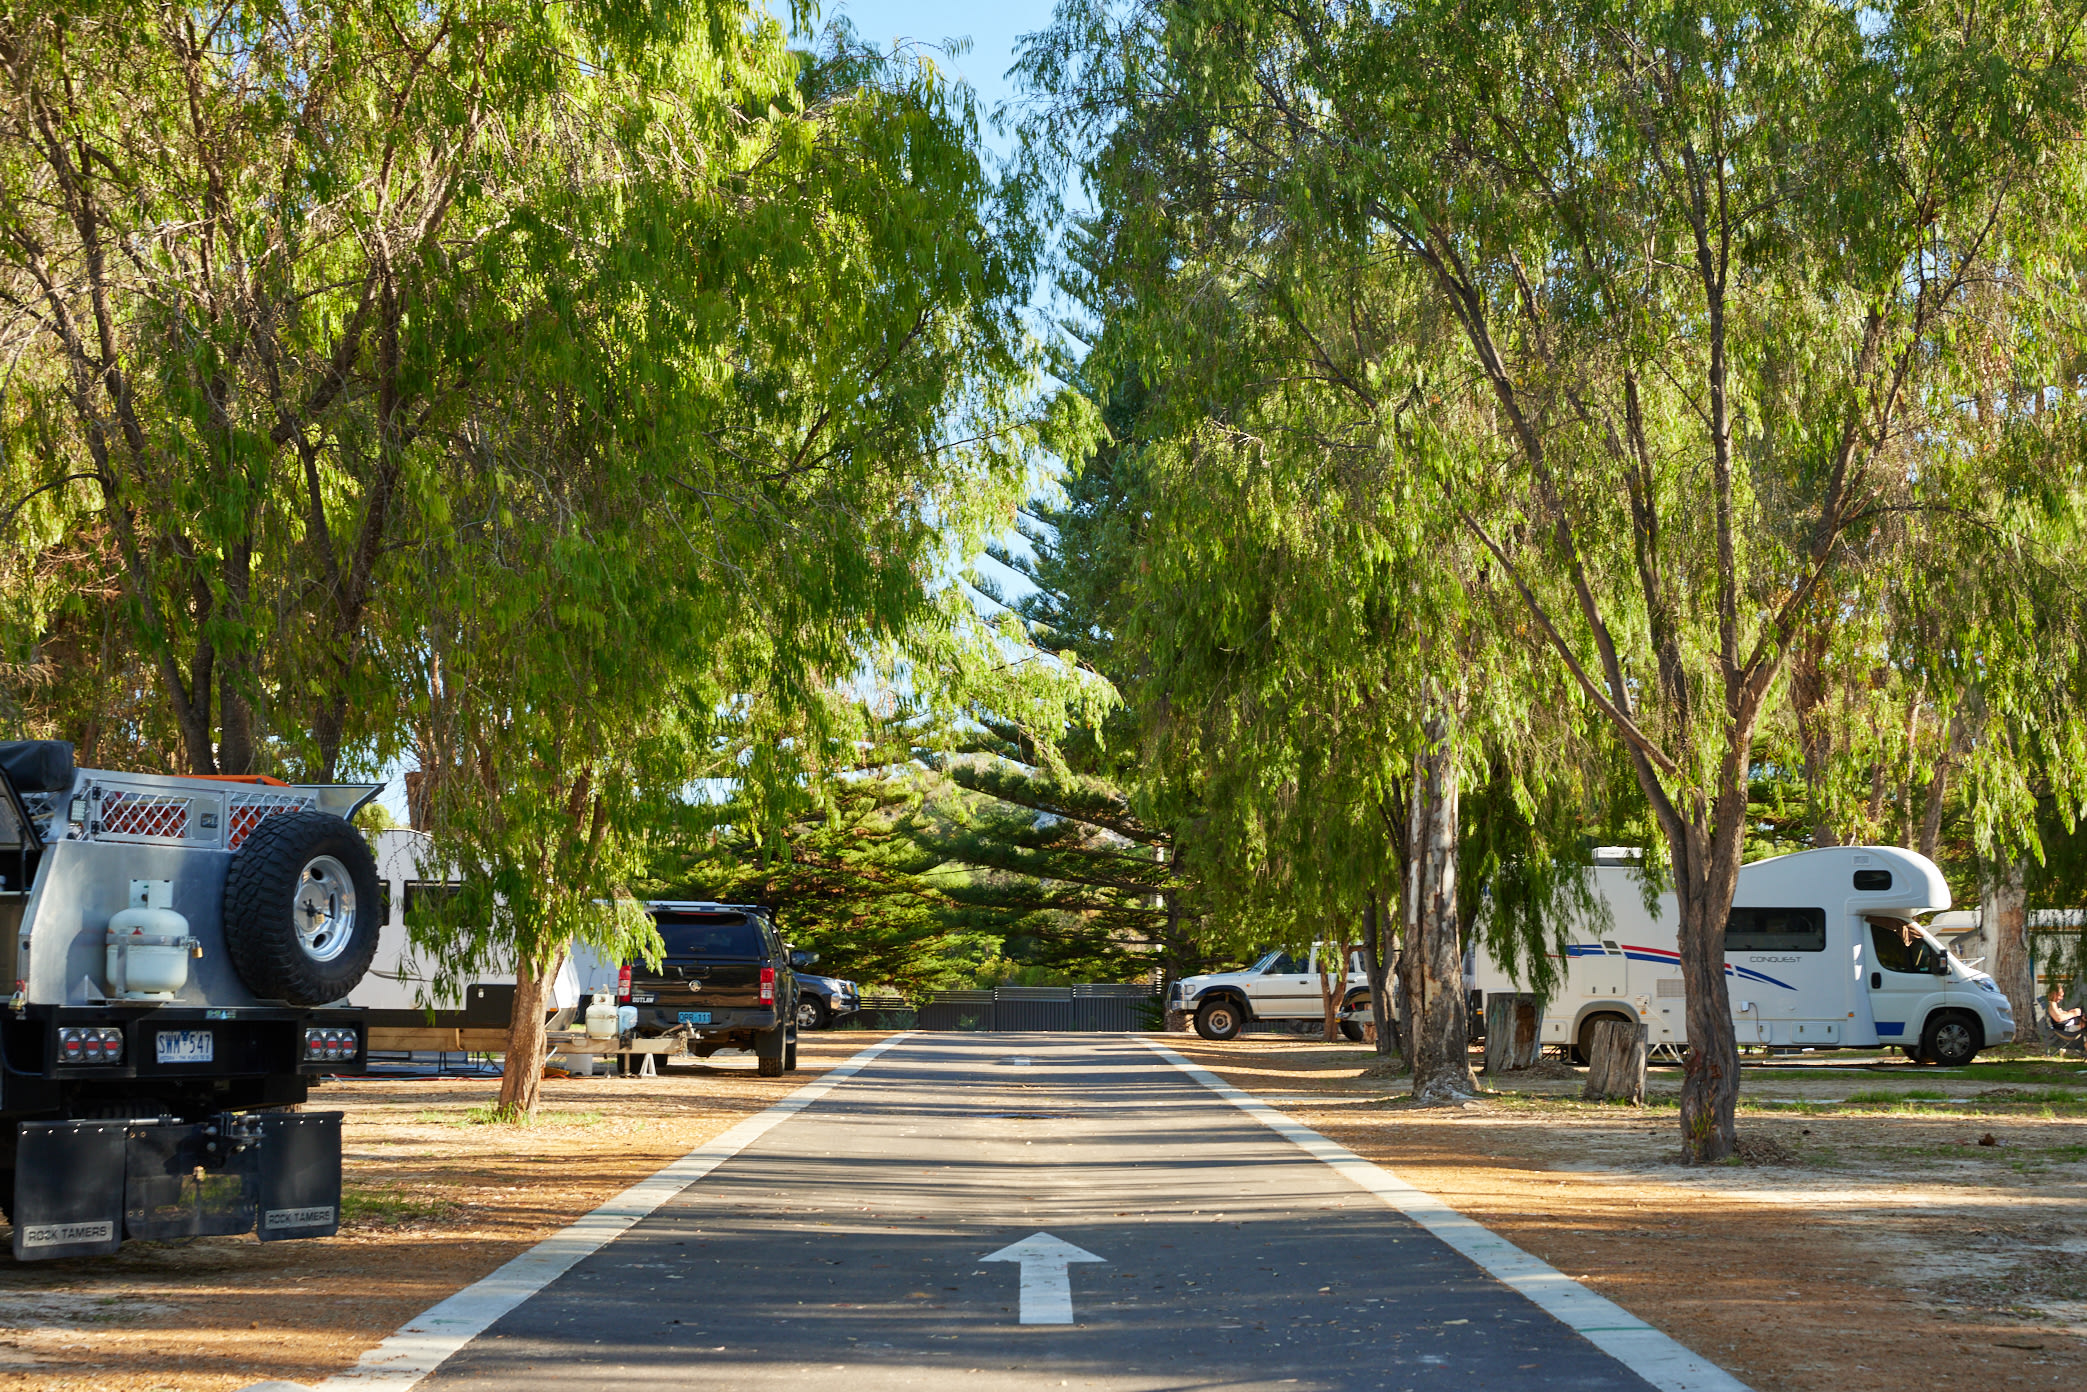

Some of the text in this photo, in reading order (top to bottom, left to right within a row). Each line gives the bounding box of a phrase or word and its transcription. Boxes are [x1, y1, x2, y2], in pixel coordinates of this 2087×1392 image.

[189, 1034, 211, 1054] 547
[268, 1210, 330, 1224] ROCK TAMERS
[28, 1226, 107, 1241] ROCK TAMERS
